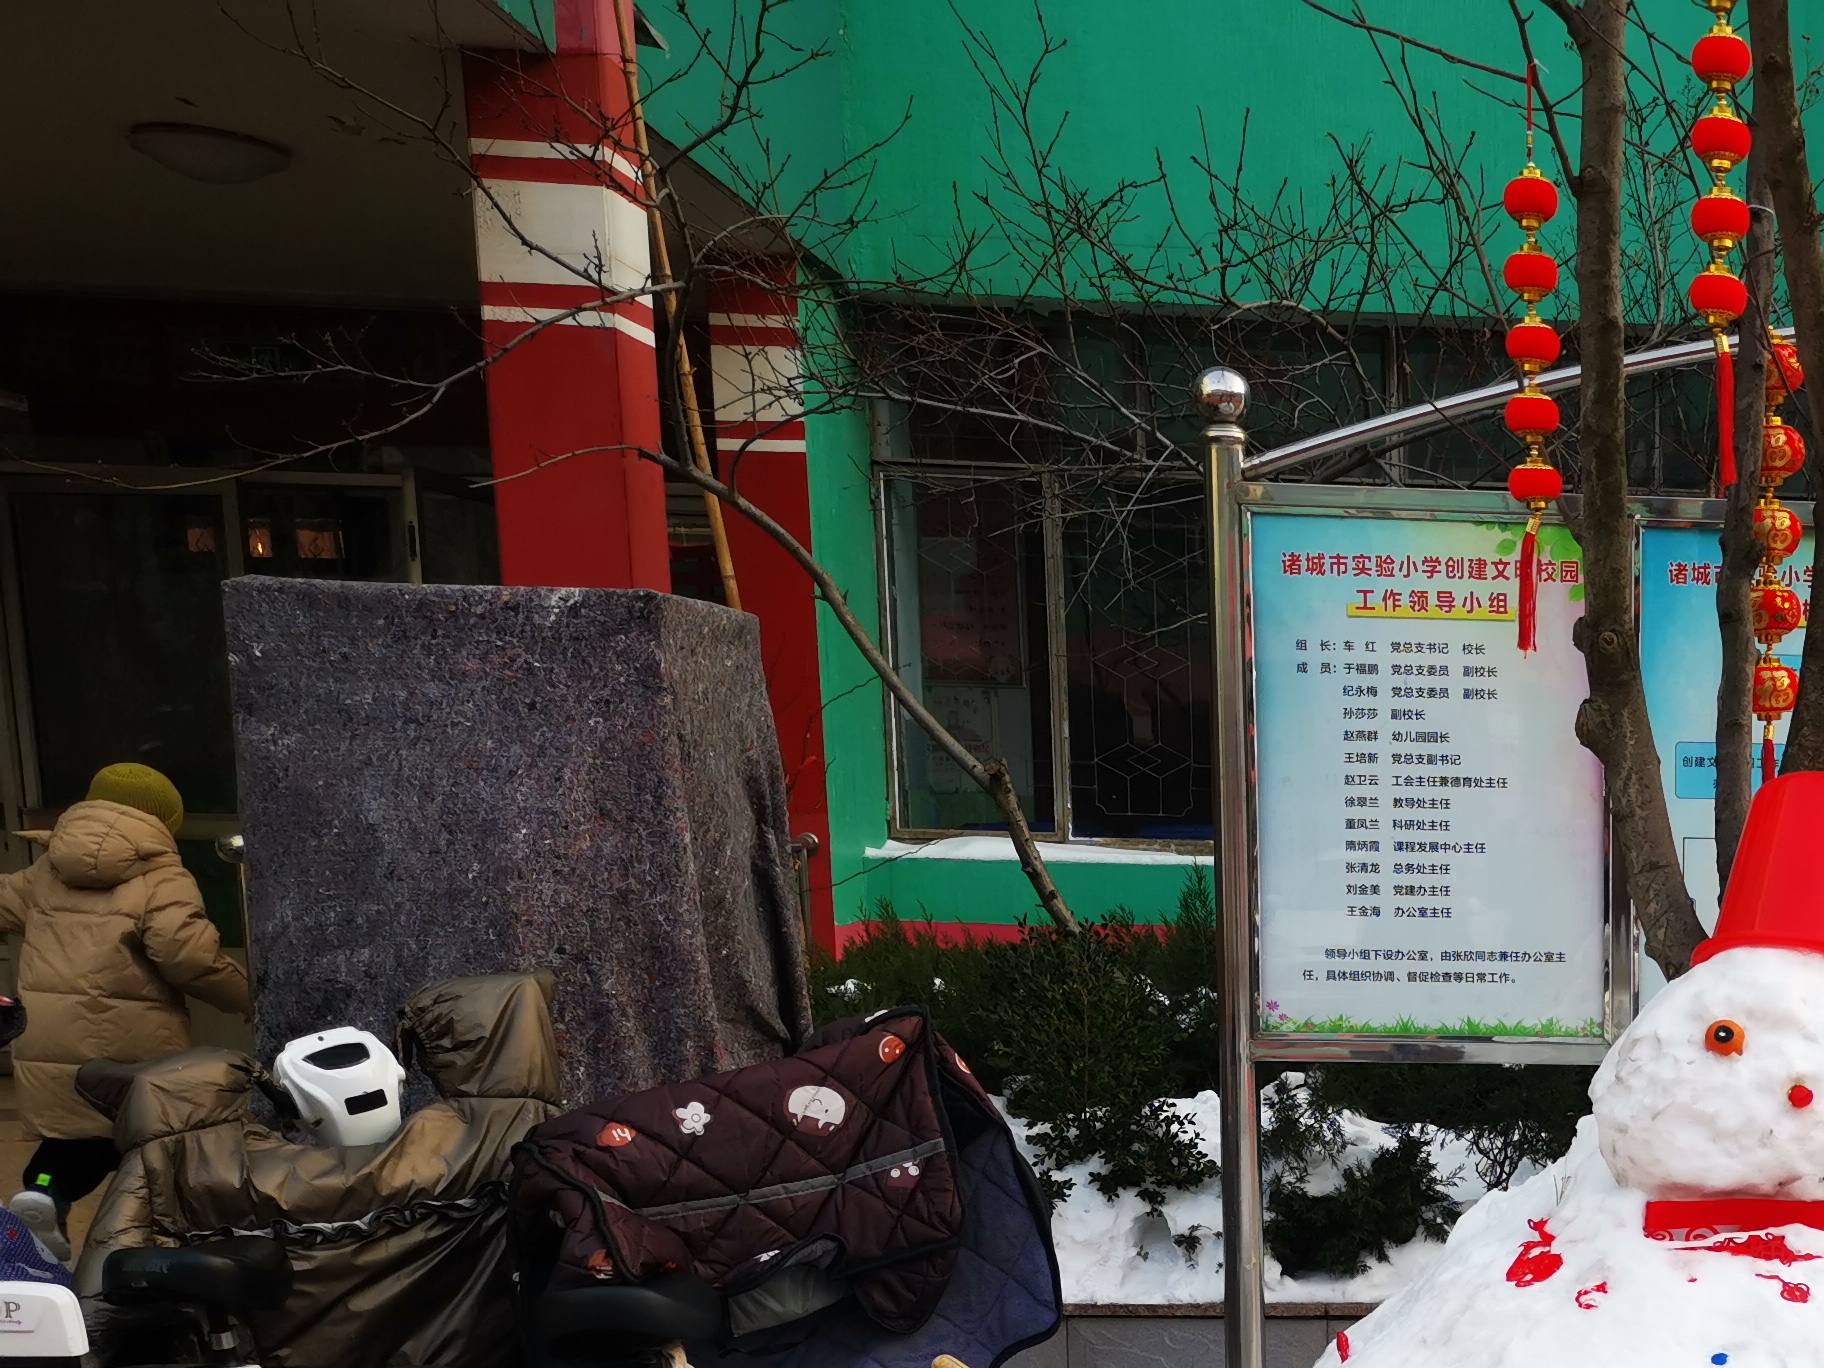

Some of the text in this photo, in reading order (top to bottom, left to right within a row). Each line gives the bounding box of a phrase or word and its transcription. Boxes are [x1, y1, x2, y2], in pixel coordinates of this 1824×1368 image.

[1281, 552, 1579, 584] 诸城市实验小学创建文校园
[1354, 589, 1509, 614] 工作领导小组
[1390, 641, 1449, 654] 党总支书记
[1462, 643, 1486, 655] 校长
[1342, 663, 1379, 676] 于福鹏
[1391, 664, 1449, 677] 党总支委员
[1462, 666, 1498, 678] 副校长
[1342, 685, 1498, 700] 纪永梅 党总支委员 副校长
[1342, 708, 1426, 721] 孙莎莎 副校长
[1342, 730, 1450, 744] 赵燕群 幼儿园园长
[1343, 752, 1461, 766] 王培新 党总支副书记
[1344, 774, 1508, 789] 赵卫云 工会主任兼德育处主任
[1344, 796, 1451, 811] 徐翠兰 教导处主任
[1345, 818, 1451, 832] 董凤兰 科研处主任
[1345, 840, 1486, 854] 隋炳霞 课程发展中心主任
[1345, 862, 1451, 876] 张清龙 总务处主任
[1346, 884, 1451, 898] 刘金美 党建办主任
[1346, 906, 1452, 919] 王金海 办公室主任
